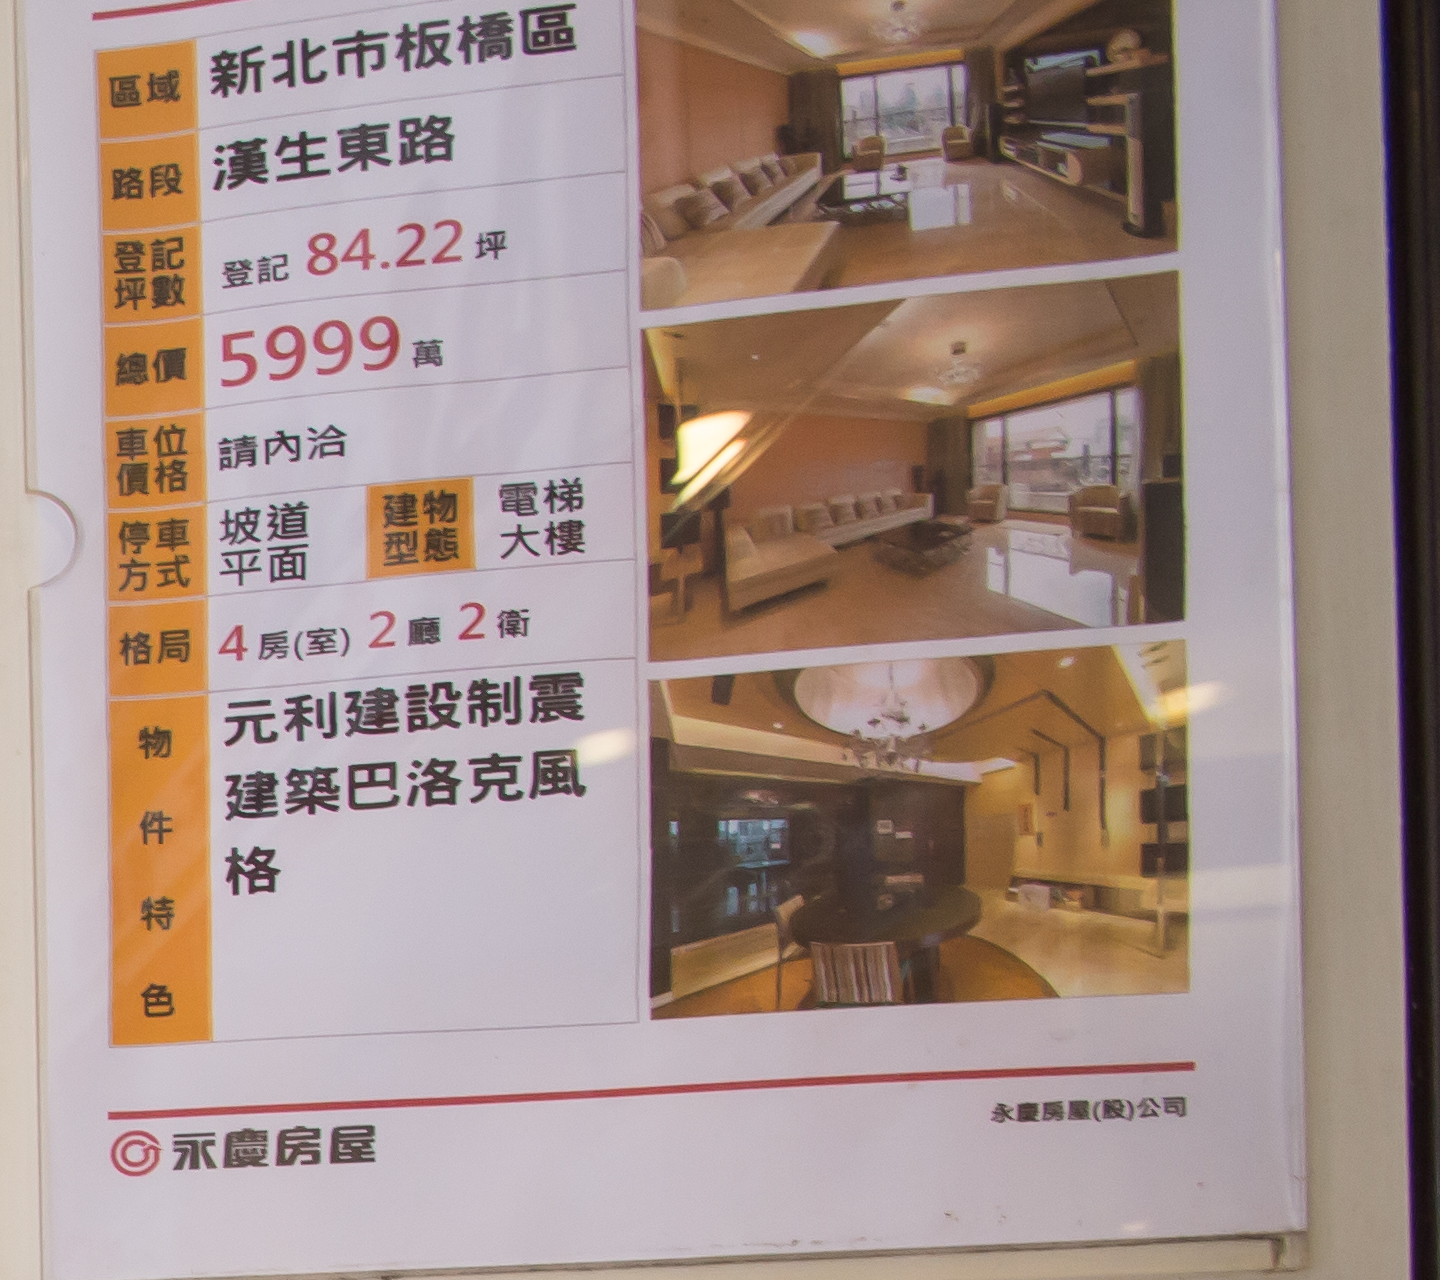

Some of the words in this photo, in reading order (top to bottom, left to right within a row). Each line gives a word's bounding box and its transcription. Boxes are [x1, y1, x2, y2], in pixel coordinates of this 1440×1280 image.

[209, 2, 577, 99] 新北市板橋區
[108, 69, 182, 109] 區域
[212, 114, 455, 192] 漢生東路
[111, 162, 183, 201] 路段
[113, 235, 186, 275] 登記
[221, 253, 290, 290] 登記
[306, 219, 463, 277] 84.22
[475, 230, 507, 260] 坪
[114, 273, 186, 311] 坪數
[115, 347, 187, 387] 總價
[220, 315, 401, 388] 5999
[411, 339, 443, 369] 萬
[115, 423, 188, 462] 車位
[217, 424, 347, 472] 請內洽
[116, 458, 189, 497] 價格
[498, 476, 584, 518] 電梯
[219, 500, 309, 546] 坡道
[383, 488, 459, 528] 建物
[118, 516, 191, 555] 停車
[384, 525, 460, 567] 型態
[500, 518, 586, 560] 大樓
[118, 553, 191, 592] 方式
[219, 543, 309, 587] 平面
[119, 628, 191, 666] 格局
[217, 624, 248, 662] 4
[257, 627, 351, 662] 房(室)
[368, 610, 396, 649] 2
[407, 616, 441, 646] 廳
[457, 601, 486, 641] 2
[496, 608, 530, 639] 衛
[224, 671, 585, 747] 元利建設制震
[224, 749, 587, 821] 建築巴洛克風
[224, 846, 281, 897] 格
[172, 1124, 376, 1171] 永慶房屋
